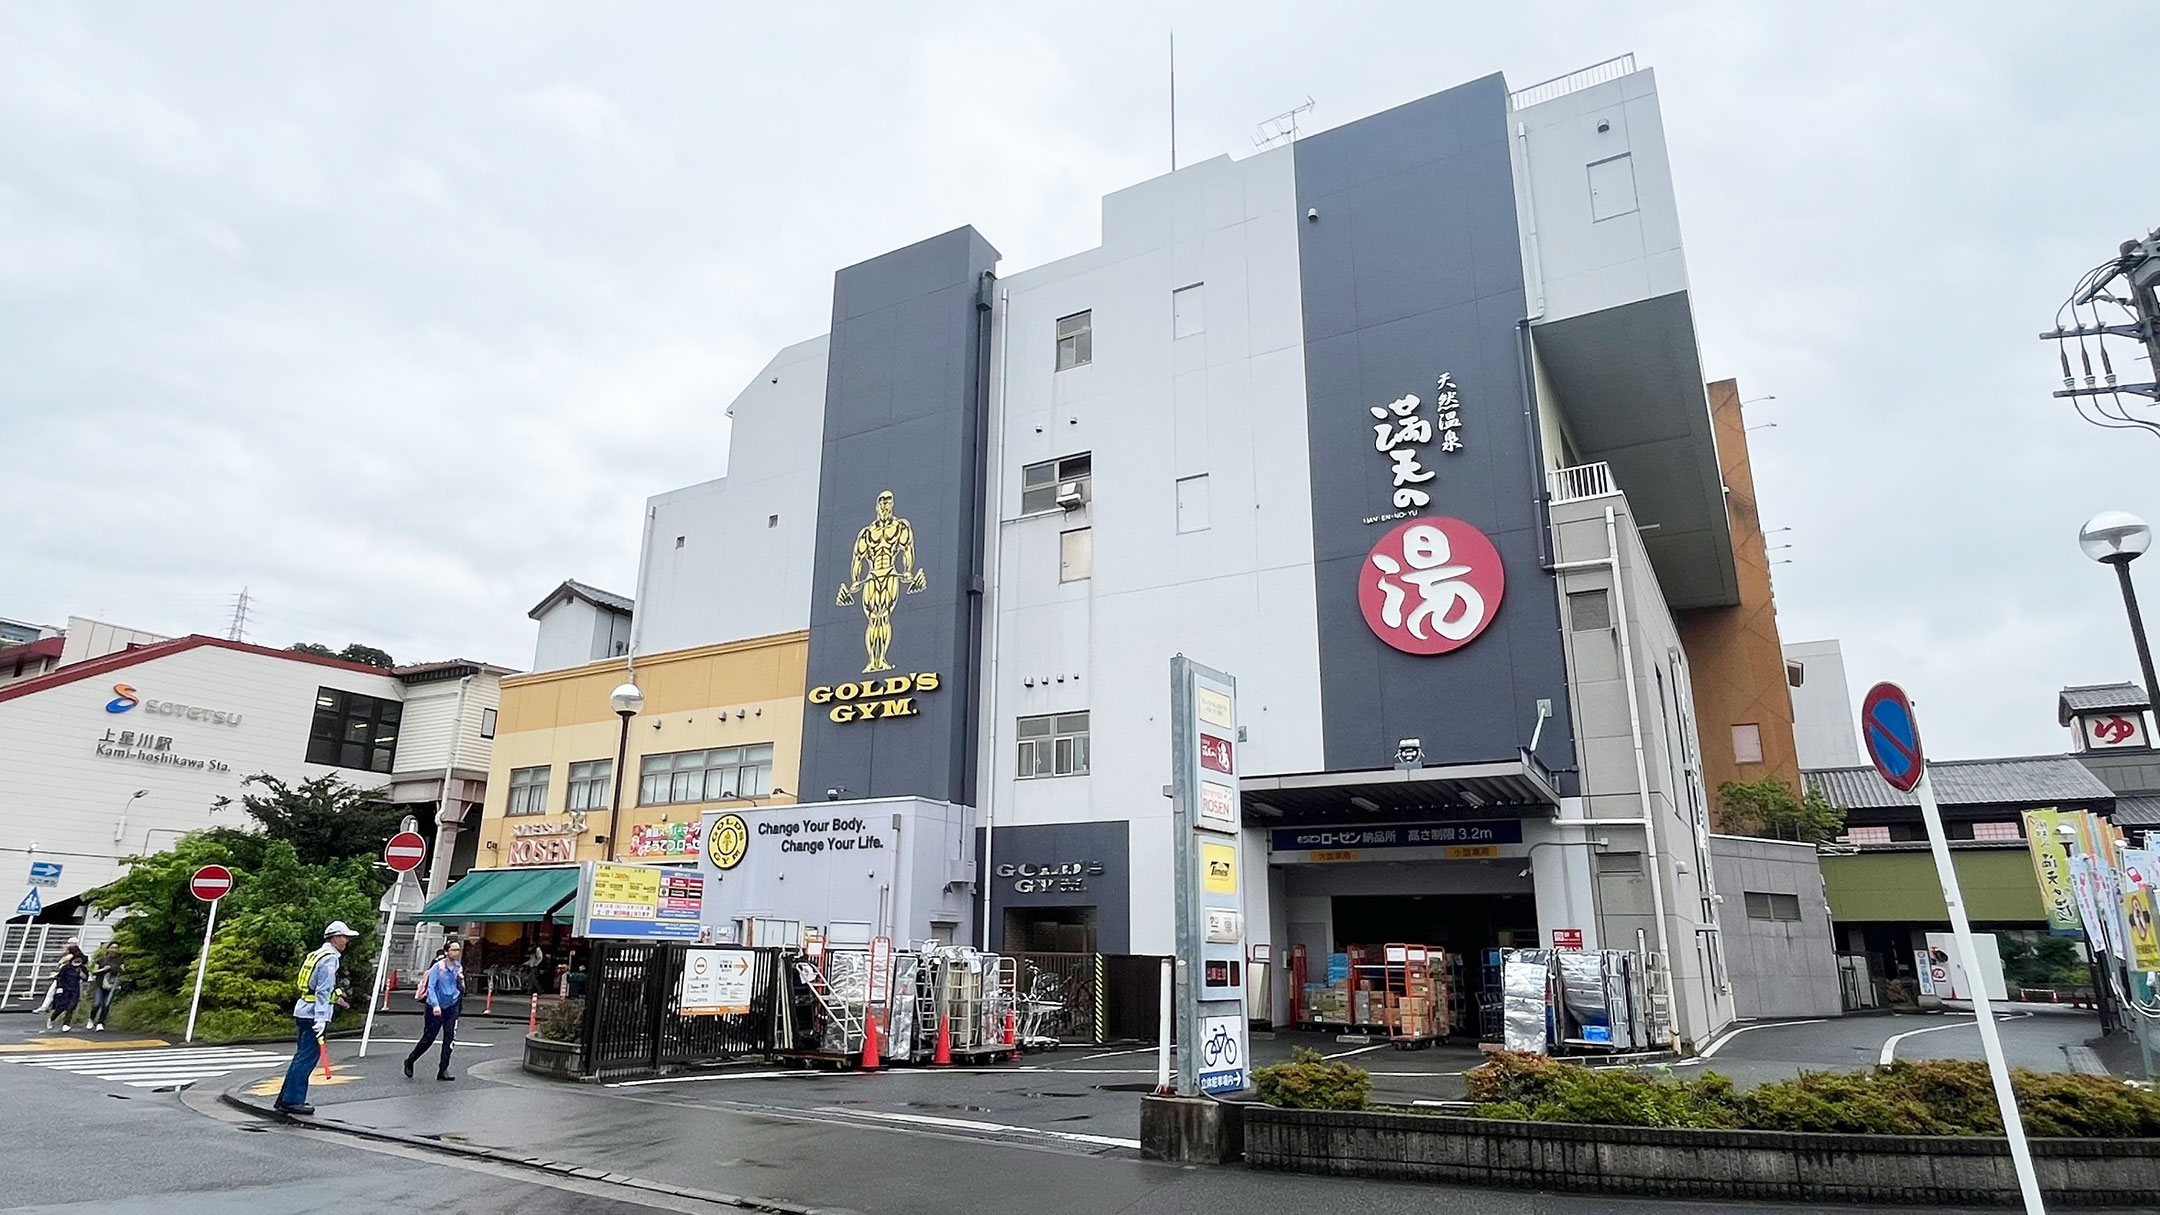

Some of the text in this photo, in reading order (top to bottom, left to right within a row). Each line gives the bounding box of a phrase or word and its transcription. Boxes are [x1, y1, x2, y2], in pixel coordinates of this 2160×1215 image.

[1437, 372, 1463, 452] 天然温泉
[808, 672, 939, 704] GOLD'S
[145, 699, 243, 727] SOTETSU
[829, 698, 918, 723] GYM.
[98, 728, 173, 751] 上星川駅
[2094, 714, 2135, 745] ゆ
[96, 743, 231, 773] Kami-hoshikawa Sta.
[1203, 799, 1229, 815] ROSEN
[758, 817, 866, 837] Change Your Body.
[507, 838, 575, 864] ROSEN
[781, 836, 884, 854] Change Your Life.
[1211, 865, 1229, 877] Times
